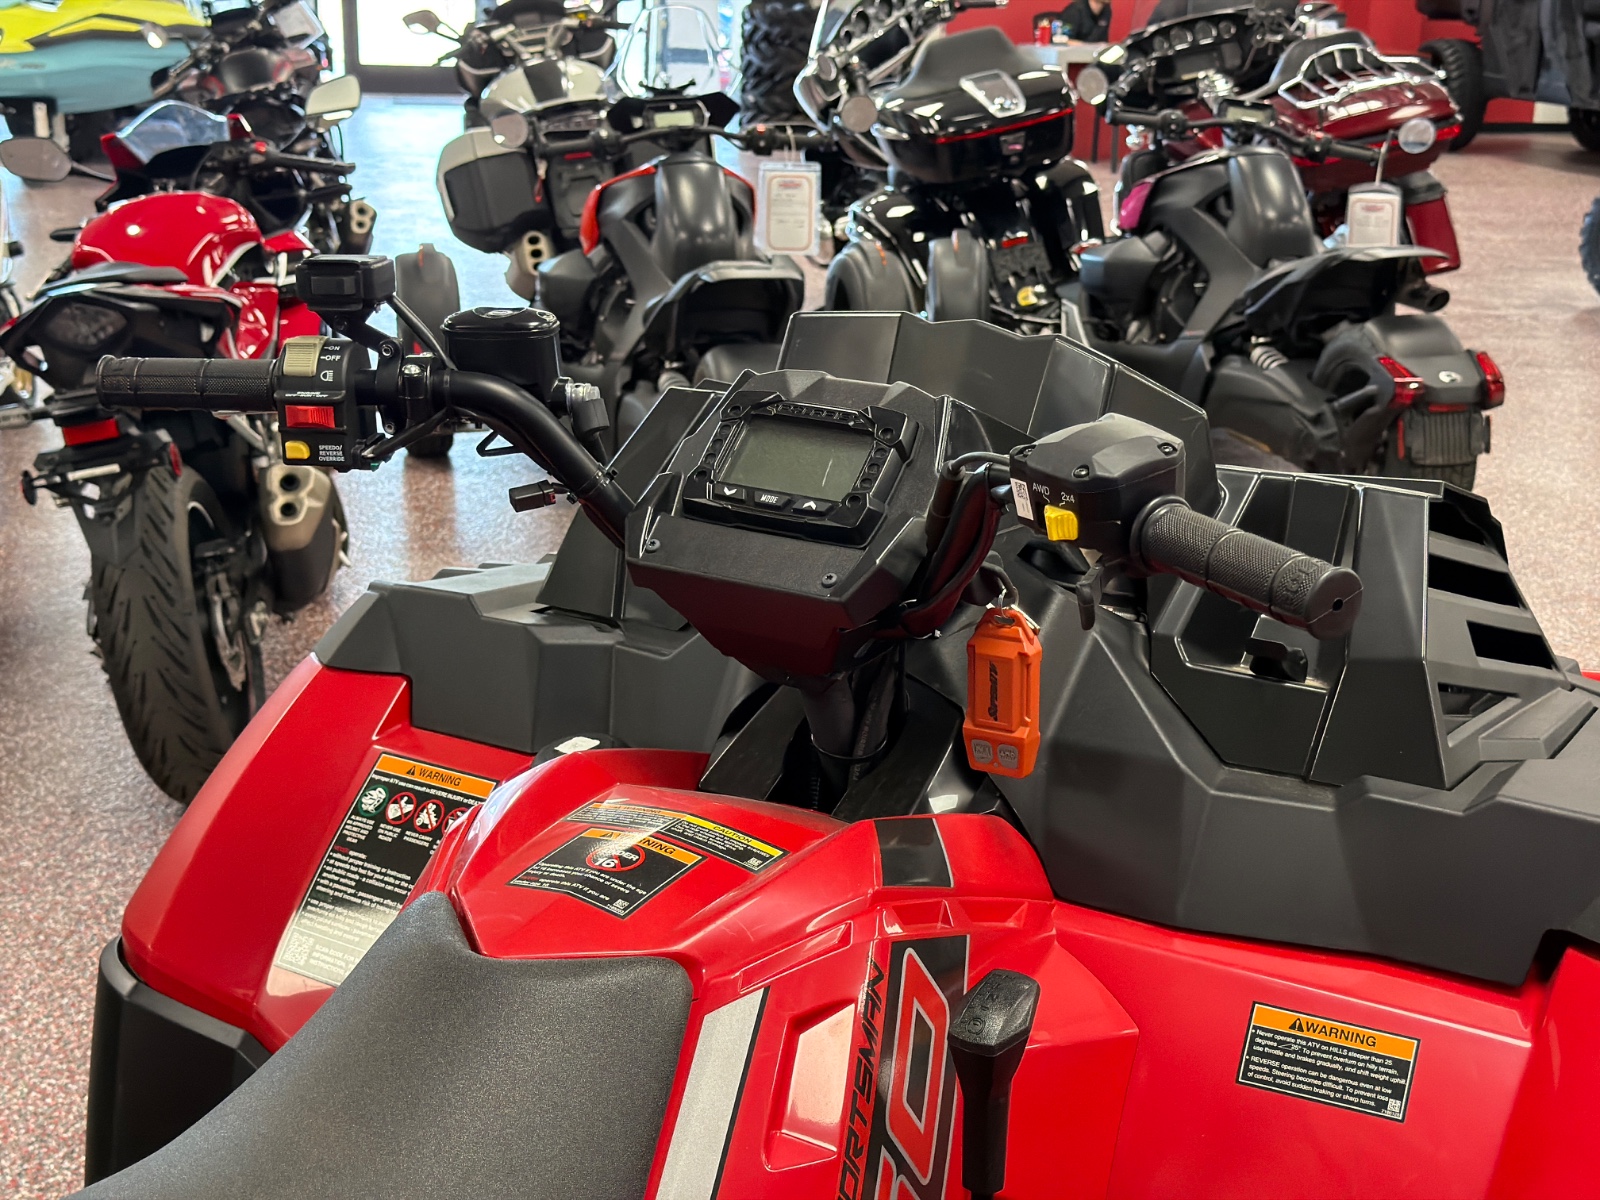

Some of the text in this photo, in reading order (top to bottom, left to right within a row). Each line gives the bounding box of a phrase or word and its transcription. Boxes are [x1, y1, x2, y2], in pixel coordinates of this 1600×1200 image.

[760, 494, 779, 504] MODE
[1032, 482, 1050, 496] AWD
[1060, 491, 1076, 504] 2x4
[419, 768, 462, 786] WARNING
[713, 826, 753, 844] CAUTION
[594, 857, 619, 868] 16
[1305, 1021, 1377, 1047] WARNING
[1255, 1037, 1278, 1047] degrees
[1311, 1051, 1332, 1060] prevent
[1333, 1056, 1356, 1065] overturn
[1366, 1063, 1378, 1071] hilly
[1274, 1034, 1295, 1043] operate
[1330, 1047, 1347, 1055] HILLS
[1349, 1051, 1370, 1061] steeper
[1251, 1056, 1280, 1067] REVERSE
[1281, 1063, 1307, 1074] operation
[1328, 1075, 1358, 1086] dangerous
[1265, 1047, 1284, 1056] throttle
[1297, 1055, 1315, 1063] brakes
[1317, 1060, 1344, 1071] gradually,
[1371, 1072, 1389, 1081] weight
[838, 955, 884, 1200] ORTSMAN
[1272, 1069, 1295, 1080] Steering
[1296, 1075, 1321, 1085] becomes
[1354, 1089, 1376, 1099] prevent
[1292, 1082, 1312, 1090] sudden
[1314, 1087, 1334, 1097] braking
[1343, 1095, 1359, 1103] sharp
